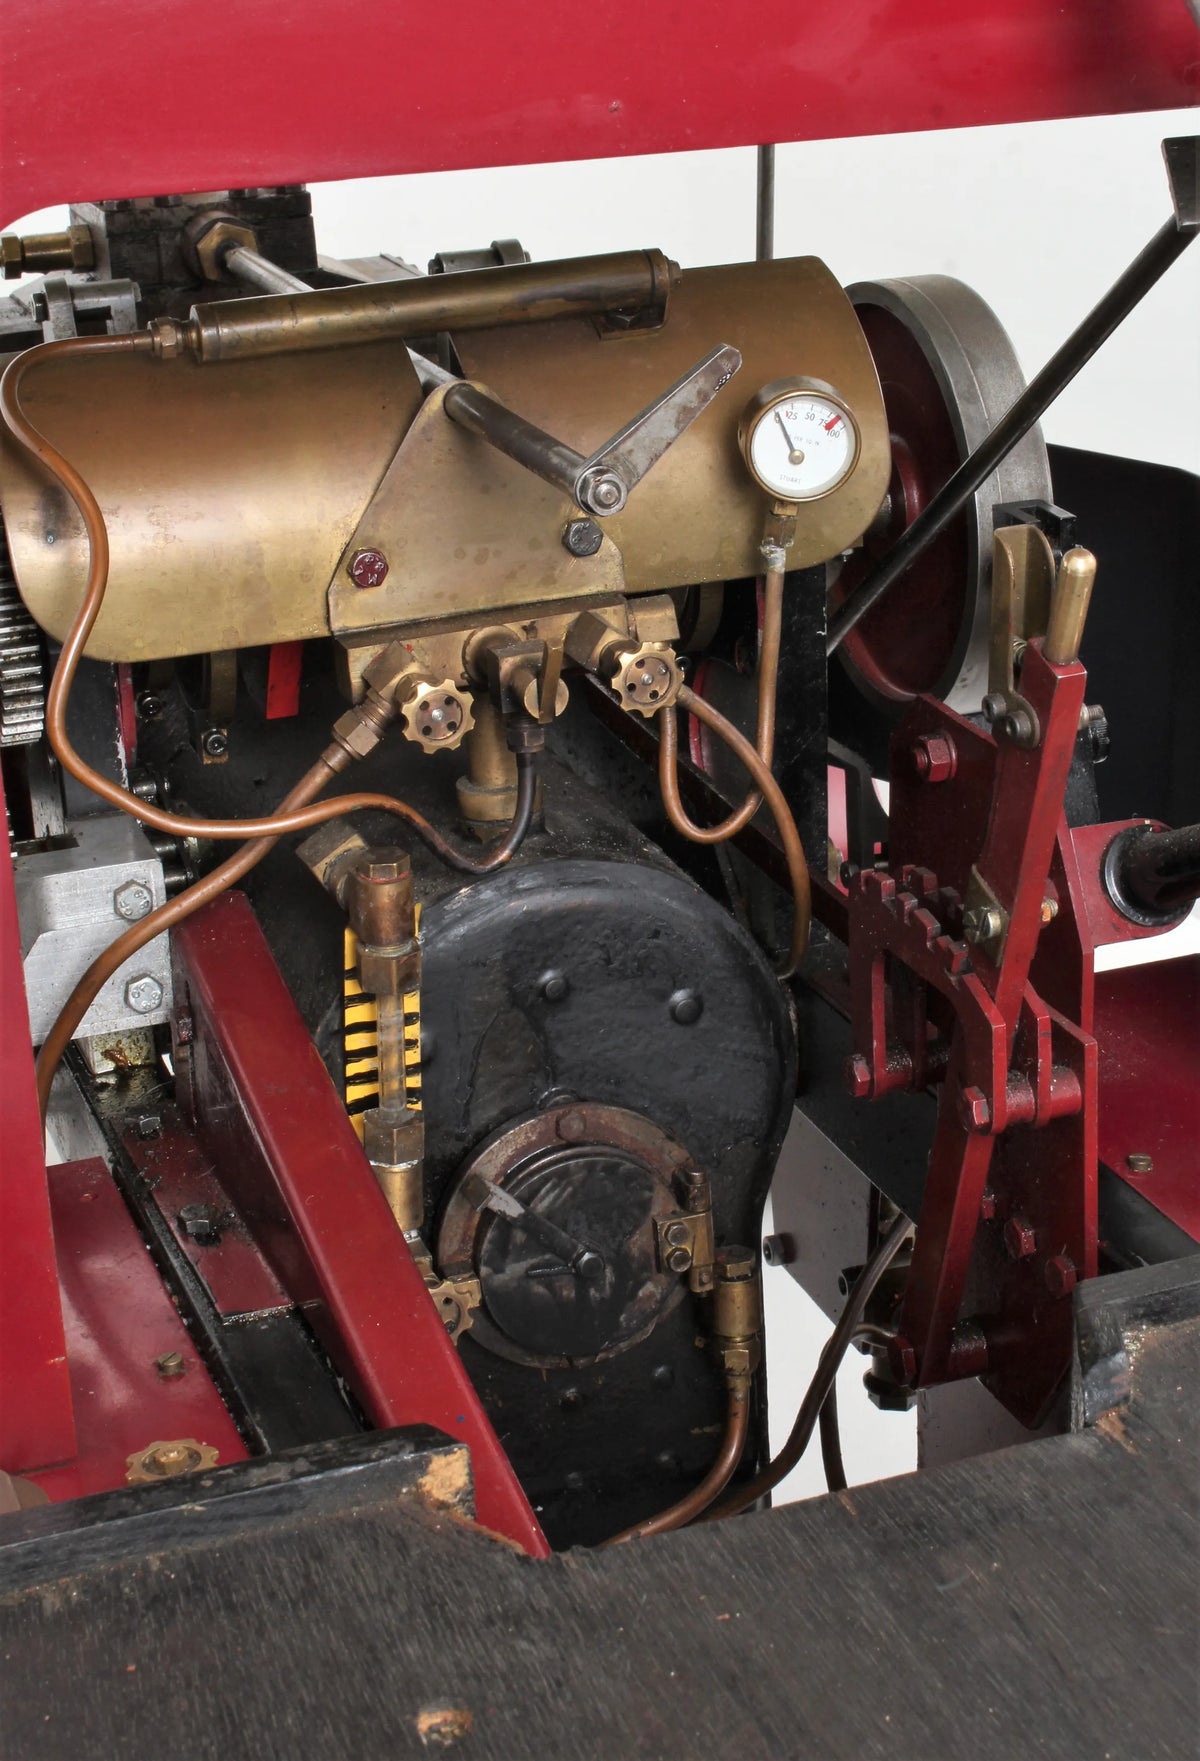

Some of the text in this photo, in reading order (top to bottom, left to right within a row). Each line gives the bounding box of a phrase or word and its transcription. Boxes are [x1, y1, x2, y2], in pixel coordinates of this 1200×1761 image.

[787, 411, 798, 421] 25
[804, 411, 816, 421] 50
[826, 429, 841, 439] 100
